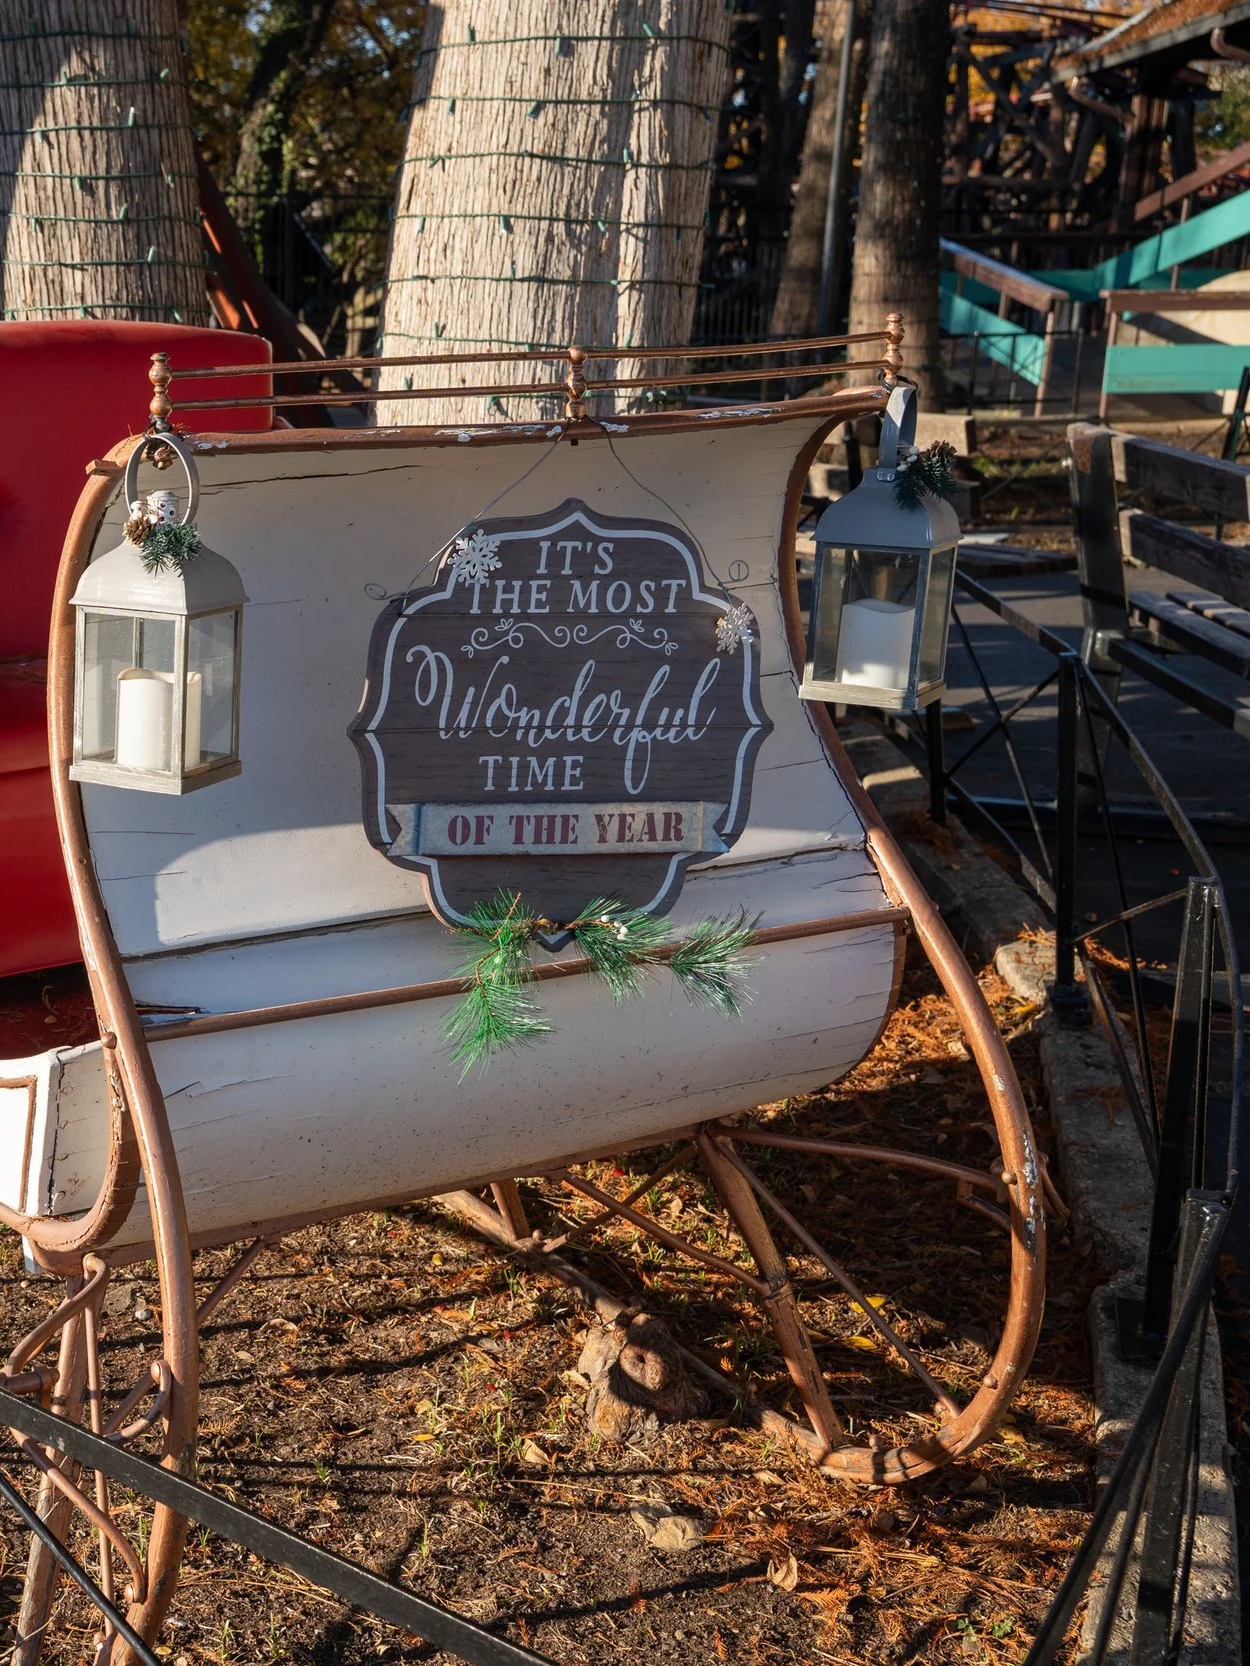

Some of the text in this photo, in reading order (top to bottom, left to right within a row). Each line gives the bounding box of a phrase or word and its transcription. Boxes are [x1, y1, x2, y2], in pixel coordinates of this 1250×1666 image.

[536, 541, 614, 575] IT'S
[465, 579, 687, 614] THE MOST
[406, 645, 721, 795] Wonderful
[479, 755, 584, 792] TIME
[447, 812, 685, 846] OF THE YEAR
